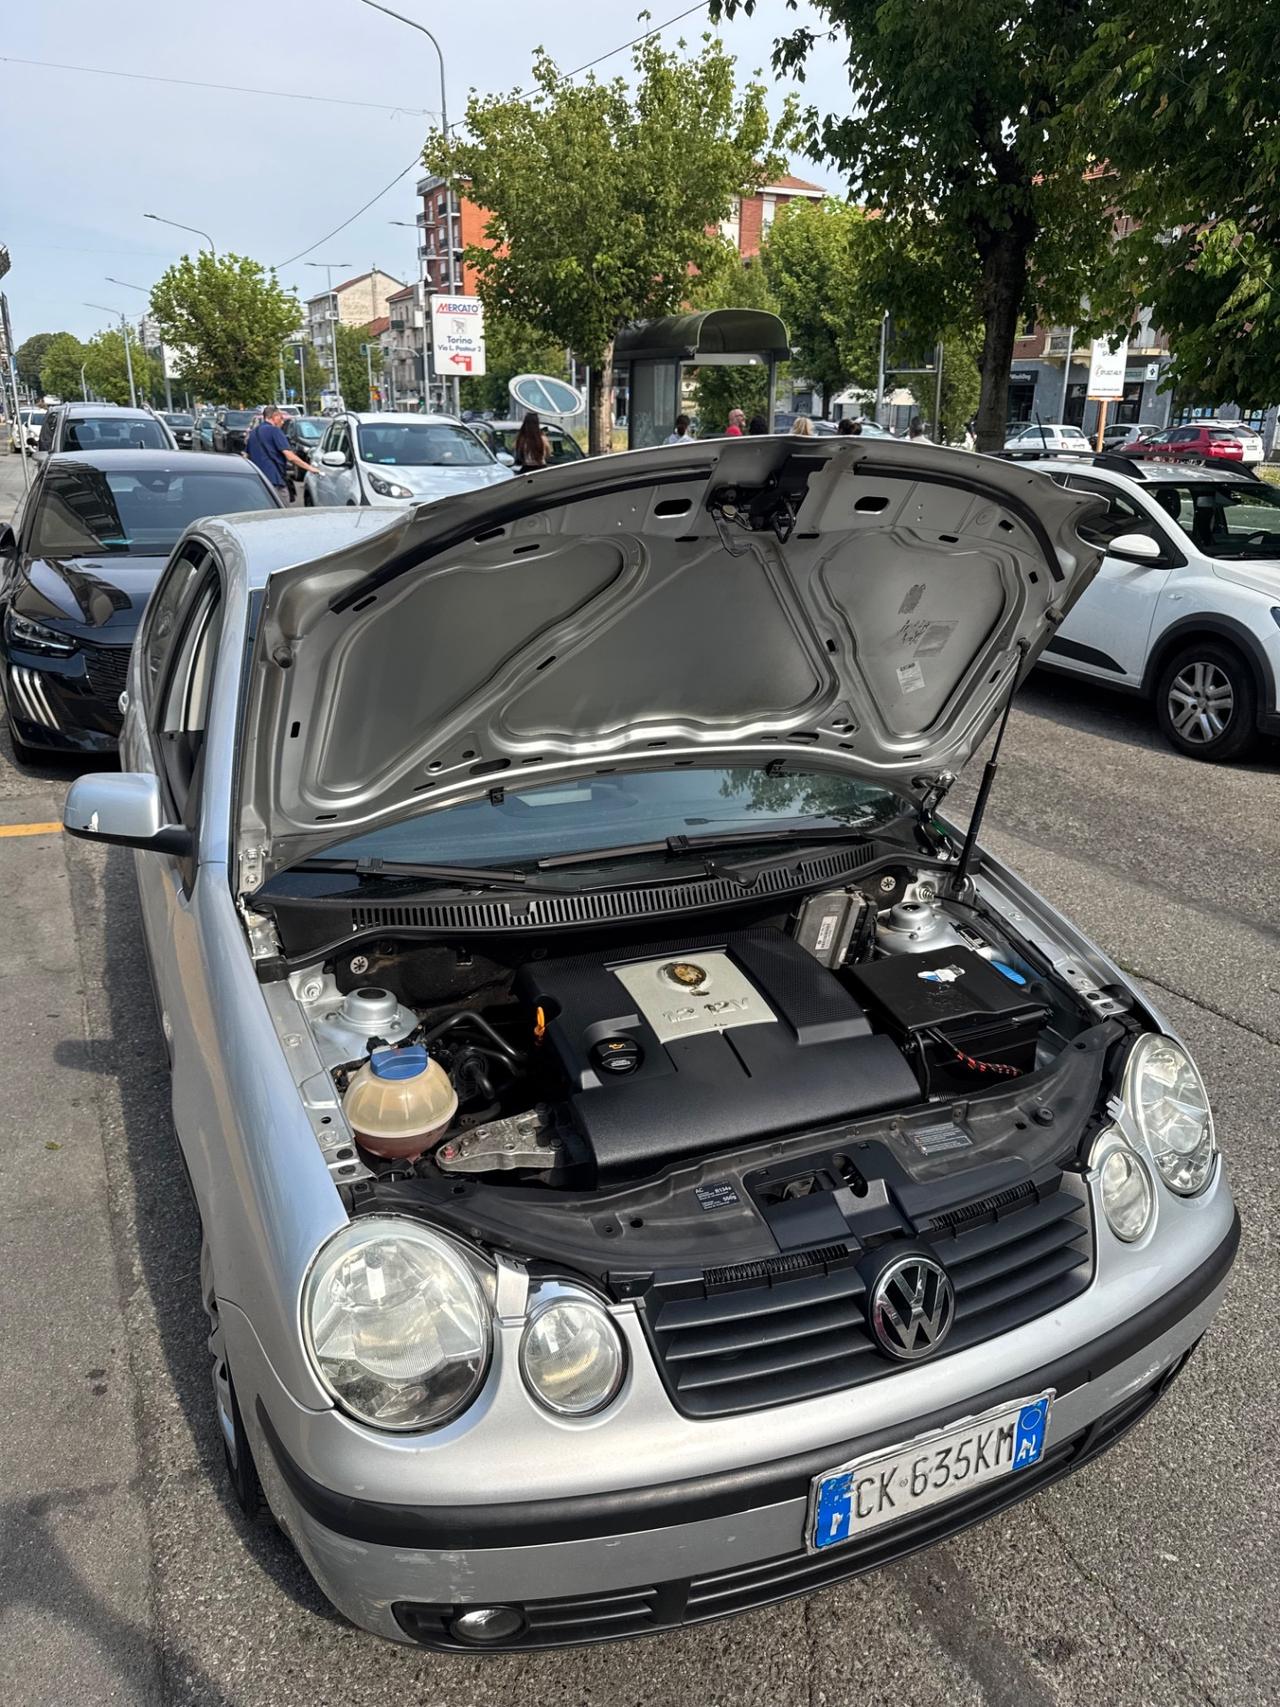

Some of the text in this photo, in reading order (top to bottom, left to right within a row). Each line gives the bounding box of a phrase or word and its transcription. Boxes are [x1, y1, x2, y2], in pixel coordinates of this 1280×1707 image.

[436, 303, 479, 314] MERCATO
[447, 335, 473, 345] Torino
[703, 997, 749, 1016] 12V
[855, 1465, 898, 1519] CK
[910, 1422, 1016, 1498] 635KM
[1016, 1433, 1037, 1464] AL
